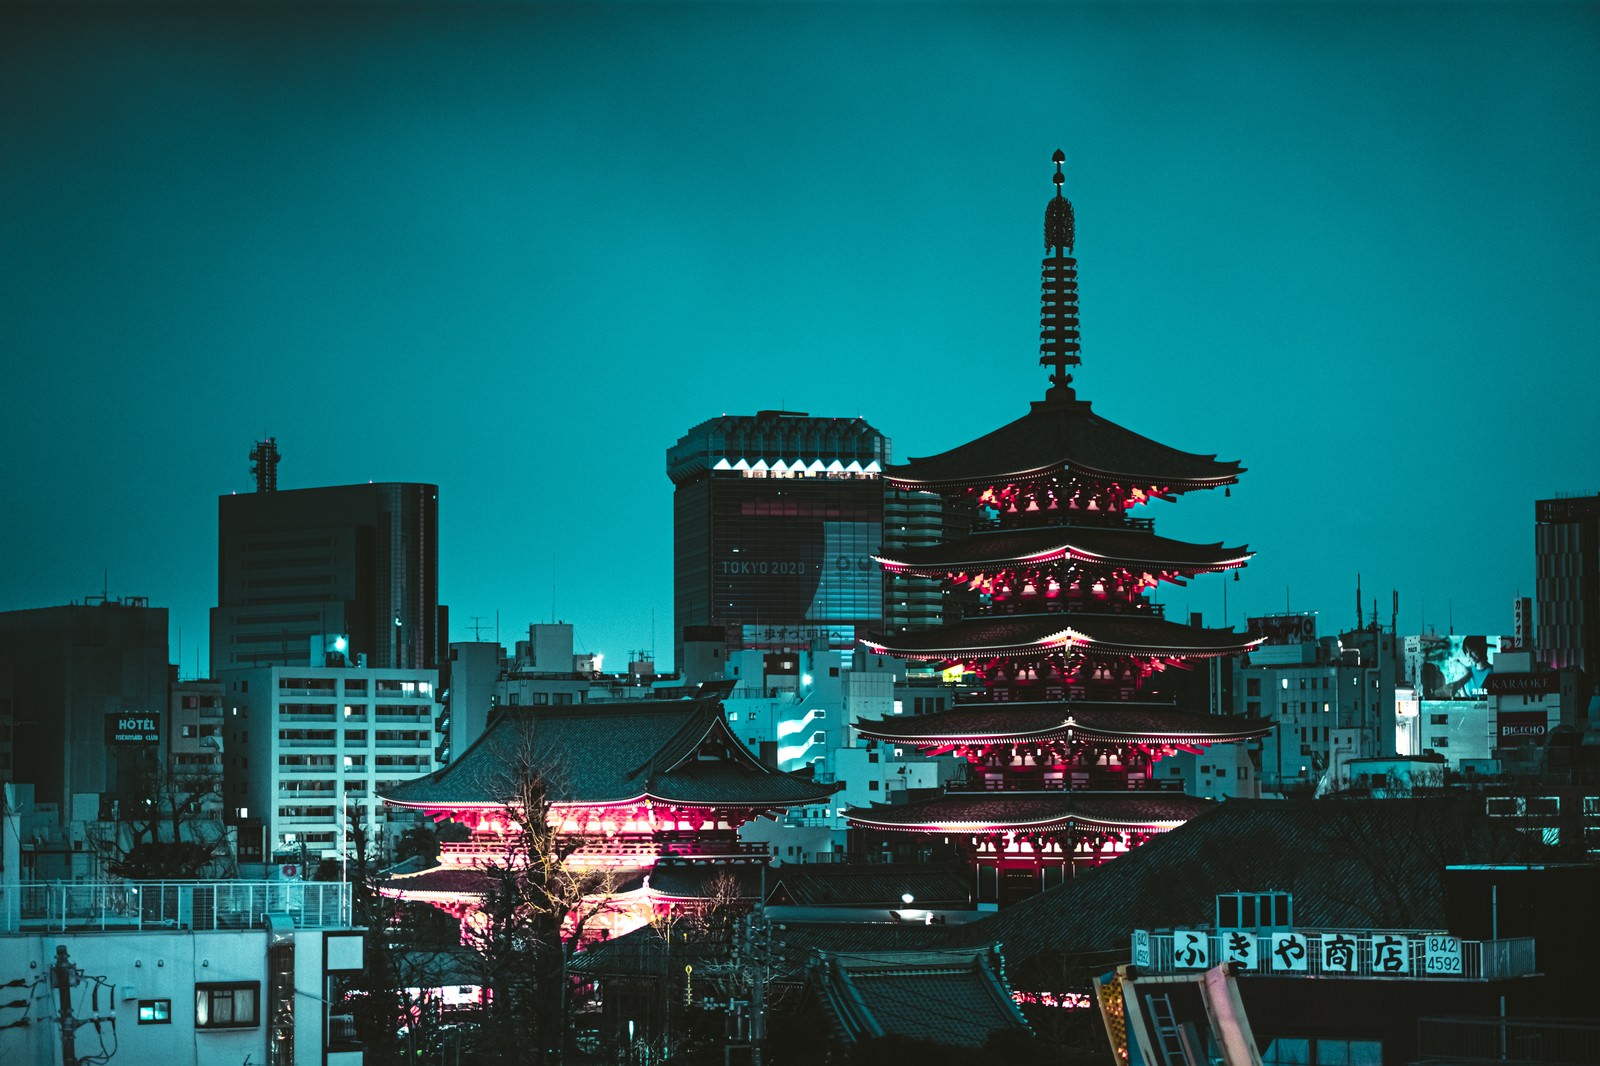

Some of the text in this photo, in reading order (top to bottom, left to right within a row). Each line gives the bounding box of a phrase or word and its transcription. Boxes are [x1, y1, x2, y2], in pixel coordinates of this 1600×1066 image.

[722, 561, 805, 575] TOKYO 2020
[1491, 678, 1550, 690] KARAOKE
[1174, 932, 1403, 972] ふきや商店
[1427, 956, 1460, 971] 4592
